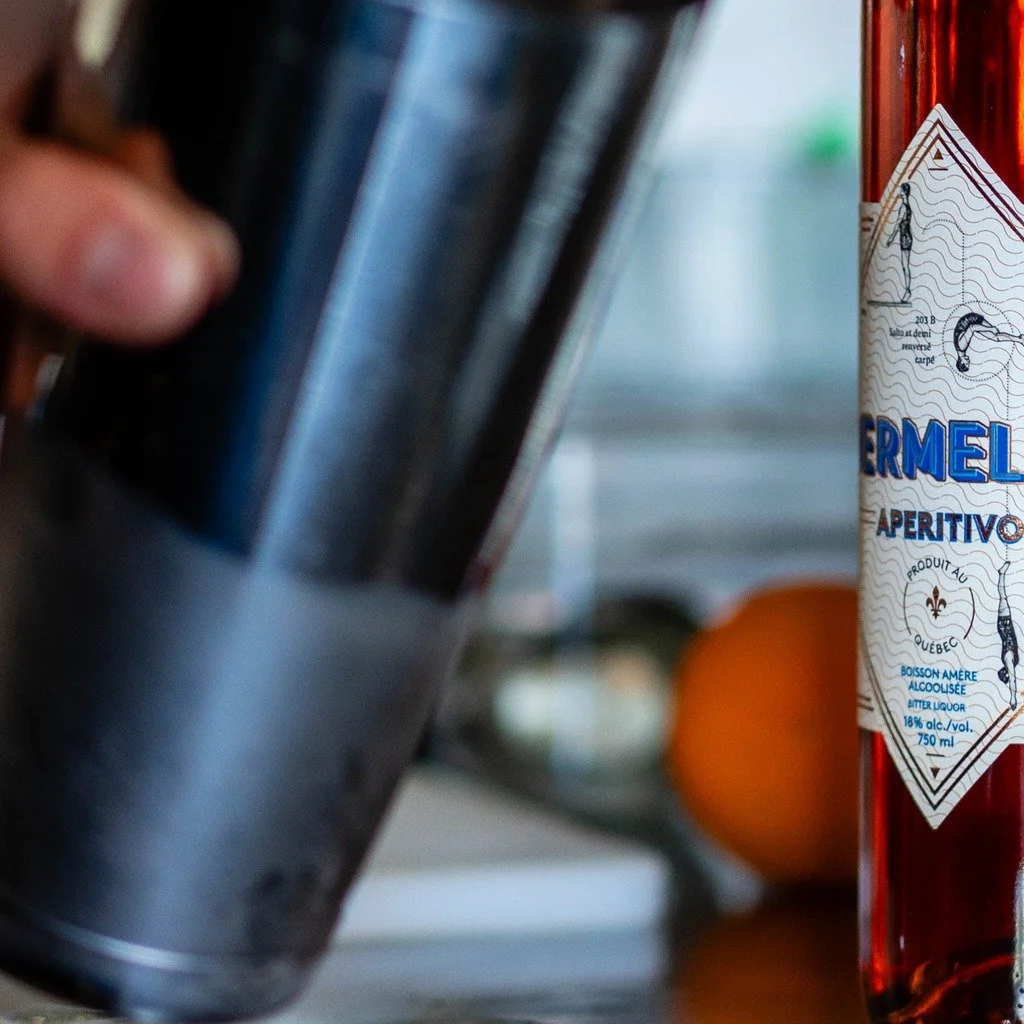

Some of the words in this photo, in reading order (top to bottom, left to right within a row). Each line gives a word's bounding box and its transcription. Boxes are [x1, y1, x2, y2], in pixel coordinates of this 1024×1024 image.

[915, 316, 928, 325] 203
[930, 316, 936, 325] B
[913, 329, 931, 338] demi
[877, 508, 1024, 544] APERITIVO
[907, 557, 951, 582] PRODUIT
[952, 568, 968, 584] AU
[914, 634, 958, 655] QUÉBEC
[901, 665, 940, 679] BOISSON
[942, 667, 978, 682] AMÈRE
[908, 681, 966, 695] ALCOOLISÉE
[908, 700, 931, 710] BITTER
[933, 701, 965, 712] LIQUOR
[904, 716, 923, 729] 18%
[926, 718, 973, 733] alc./vol.
[918, 733, 936, 747] 750
[940, 736, 954, 747] ml
